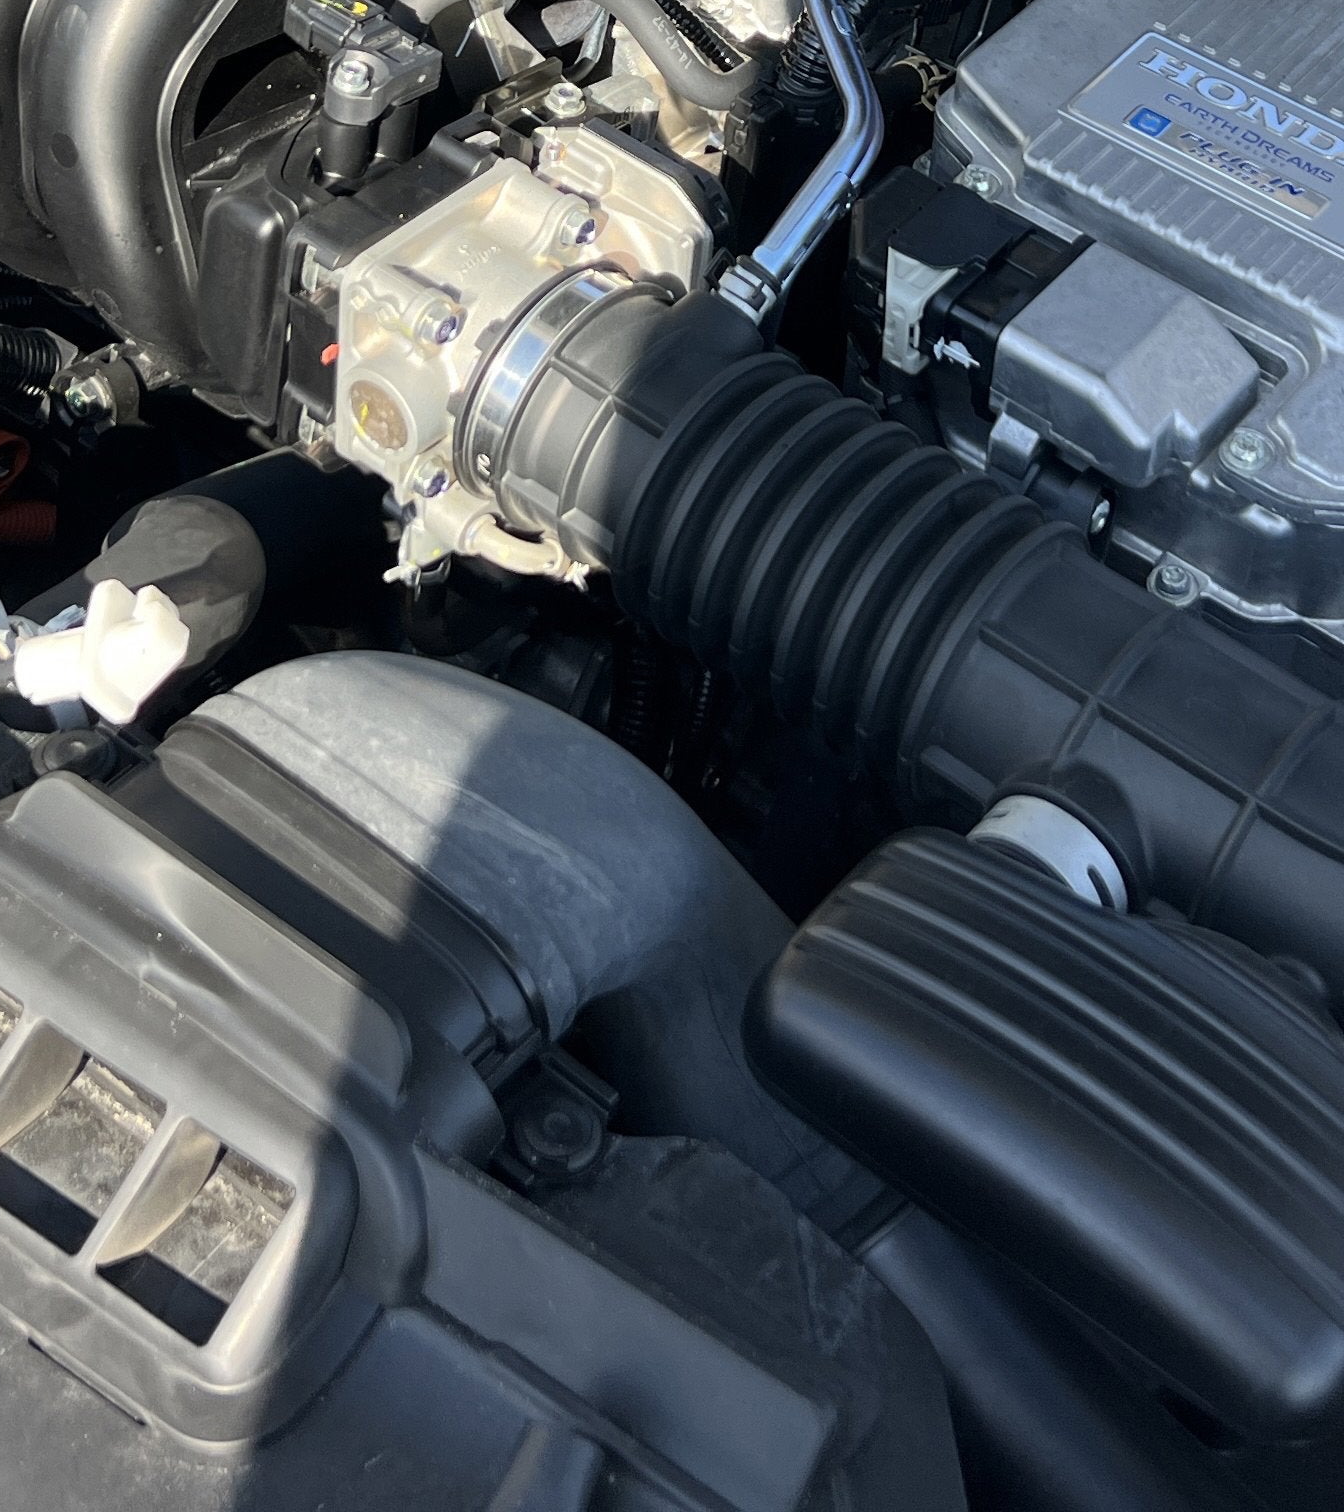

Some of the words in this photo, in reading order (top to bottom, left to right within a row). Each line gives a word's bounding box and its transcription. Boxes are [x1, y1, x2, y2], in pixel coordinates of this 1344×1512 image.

[1164, 93, 1239, 136] EARTH
[1240, 130, 1335, 183] DREAMS
[1179, 132, 1305, 197] PLUG-IN
